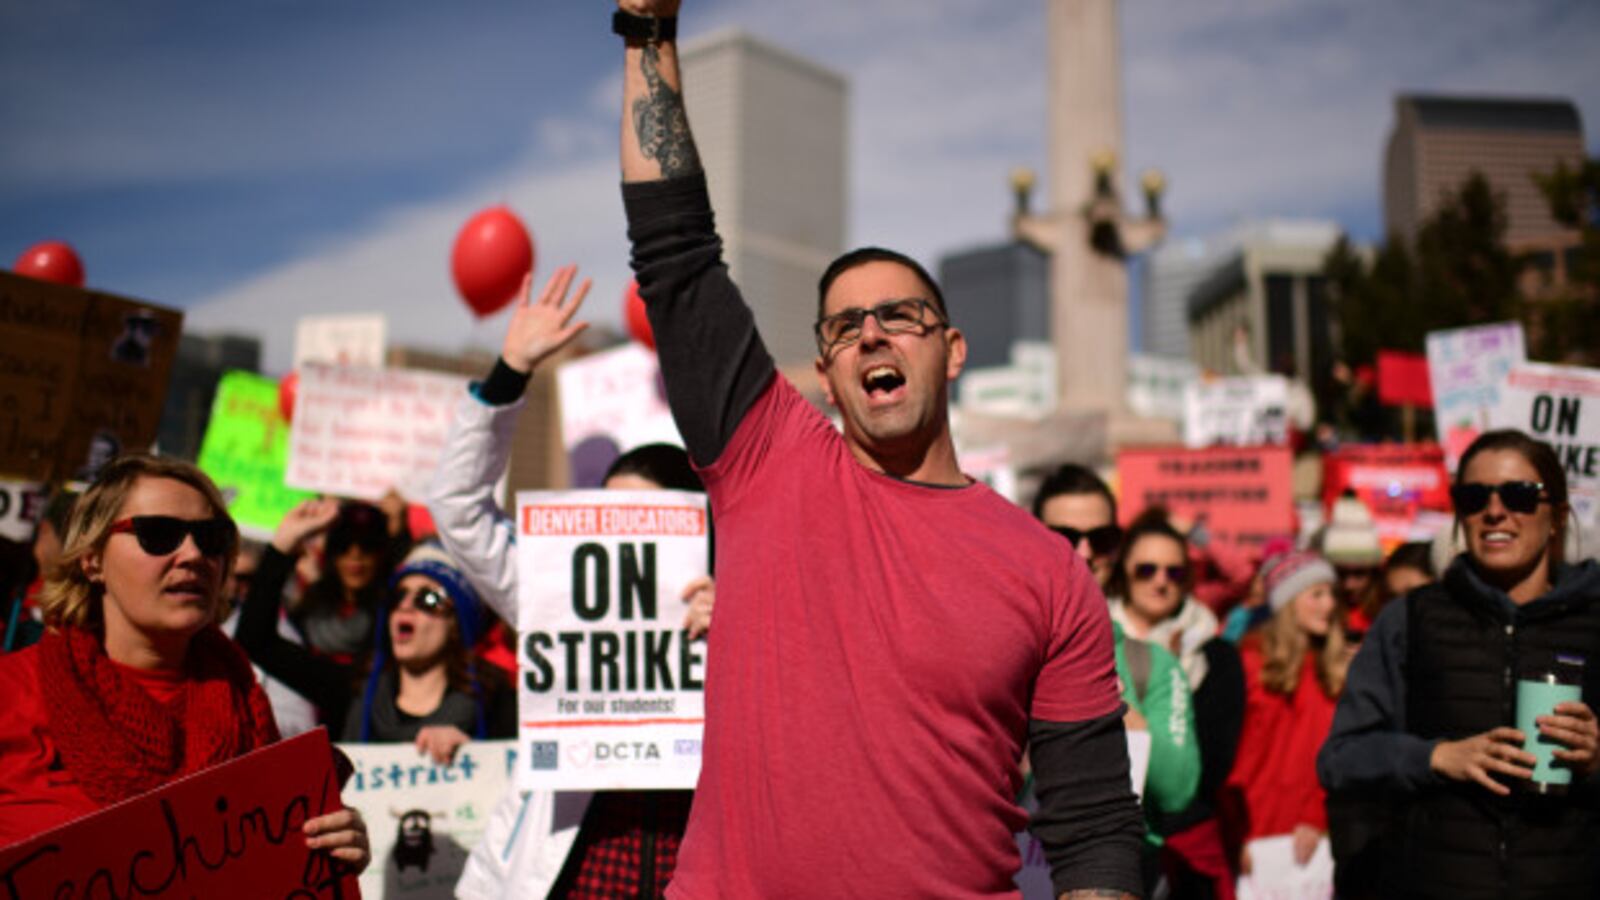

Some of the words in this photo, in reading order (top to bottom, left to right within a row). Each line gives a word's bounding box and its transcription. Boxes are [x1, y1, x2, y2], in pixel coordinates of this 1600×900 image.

[1530, 393, 1581, 436] ON
[530, 508, 597, 535] DENVER
[601, 508, 700, 536] EDUCATORS
[572, 542, 657, 621] ON
[524, 630, 704, 693] STRIKE
[557, 698, 579, 714] For
[583, 699, 604, 714] our
[610, 697, 676, 715] students!
[594, 741, 661, 760] DCTA
[355, 753, 479, 791] istrict
[1, 771, 331, 900] Teaching
